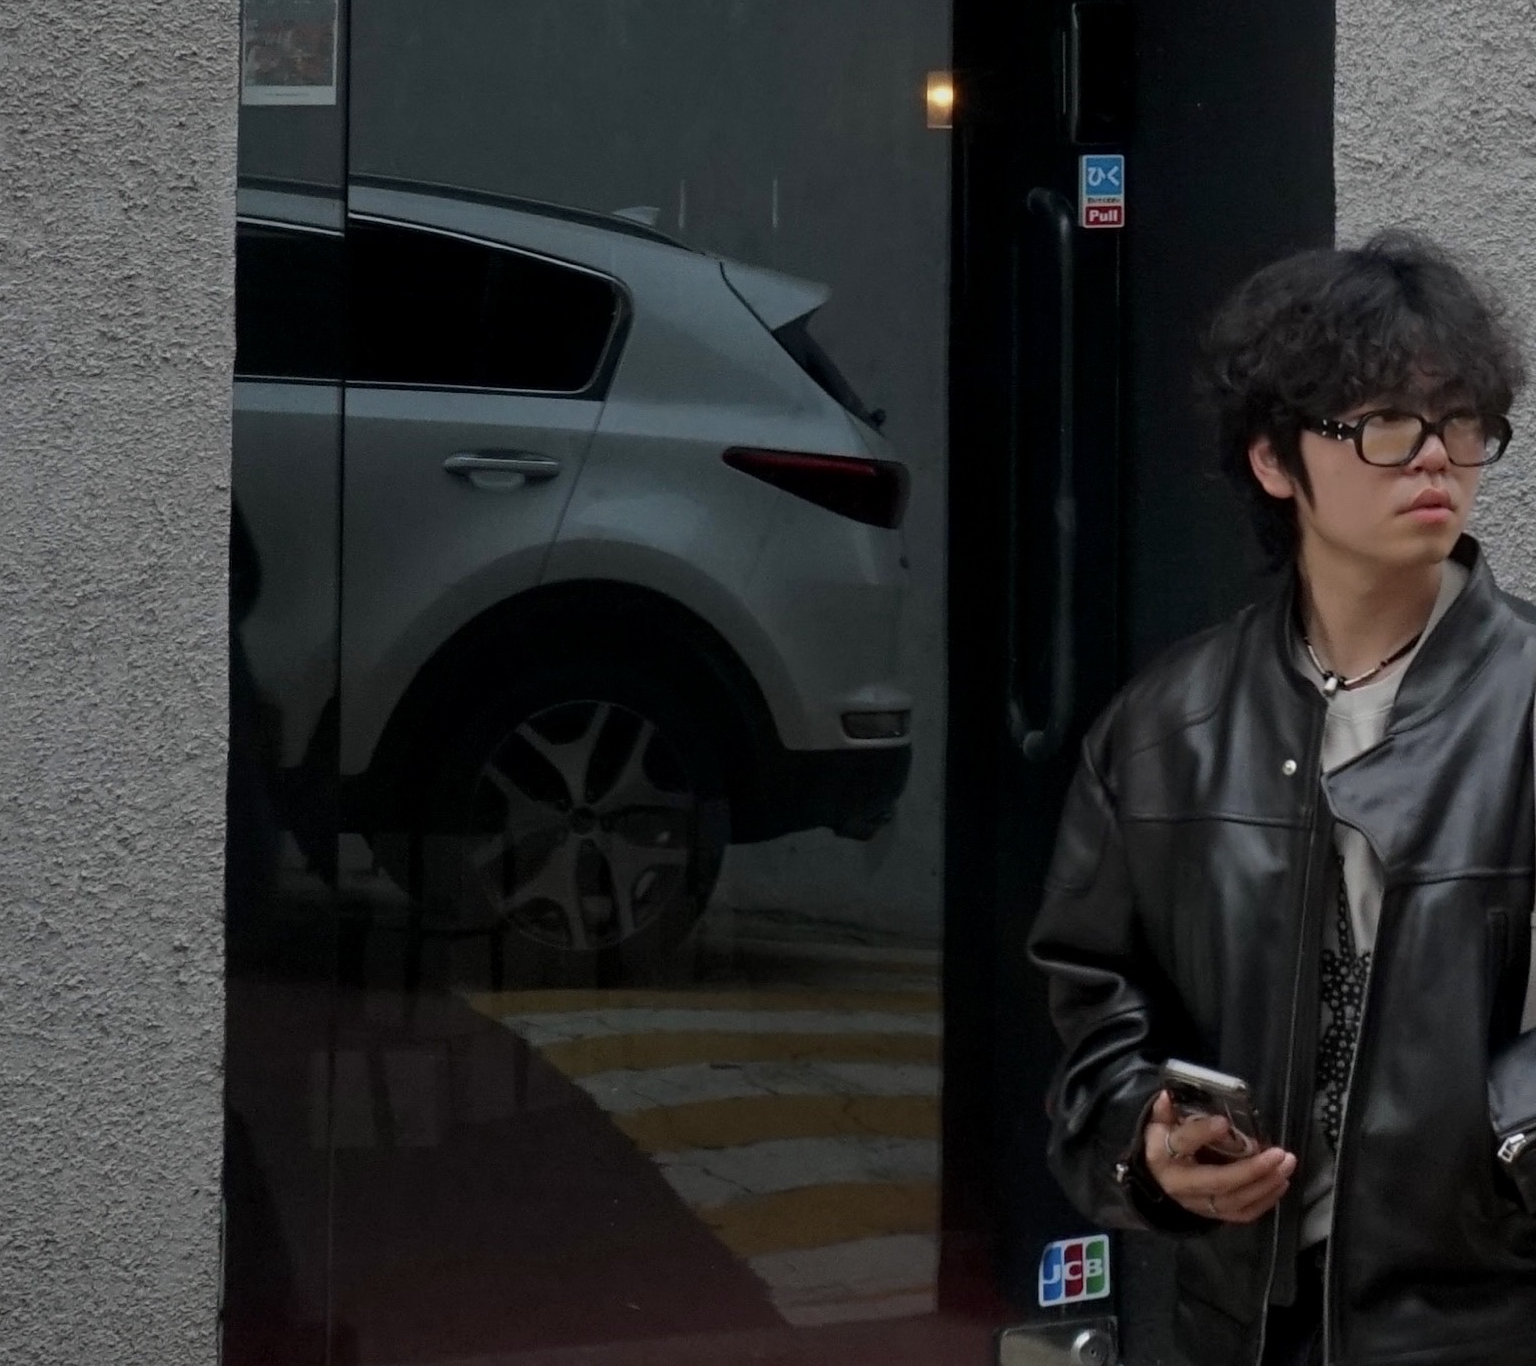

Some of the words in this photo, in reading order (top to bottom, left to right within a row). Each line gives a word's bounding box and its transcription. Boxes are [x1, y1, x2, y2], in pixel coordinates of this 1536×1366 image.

[1087, 165, 1120, 187] ひく
[1089, 209, 1118, 222] Pull
[1042, 1258, 1103, 1285] JCB
